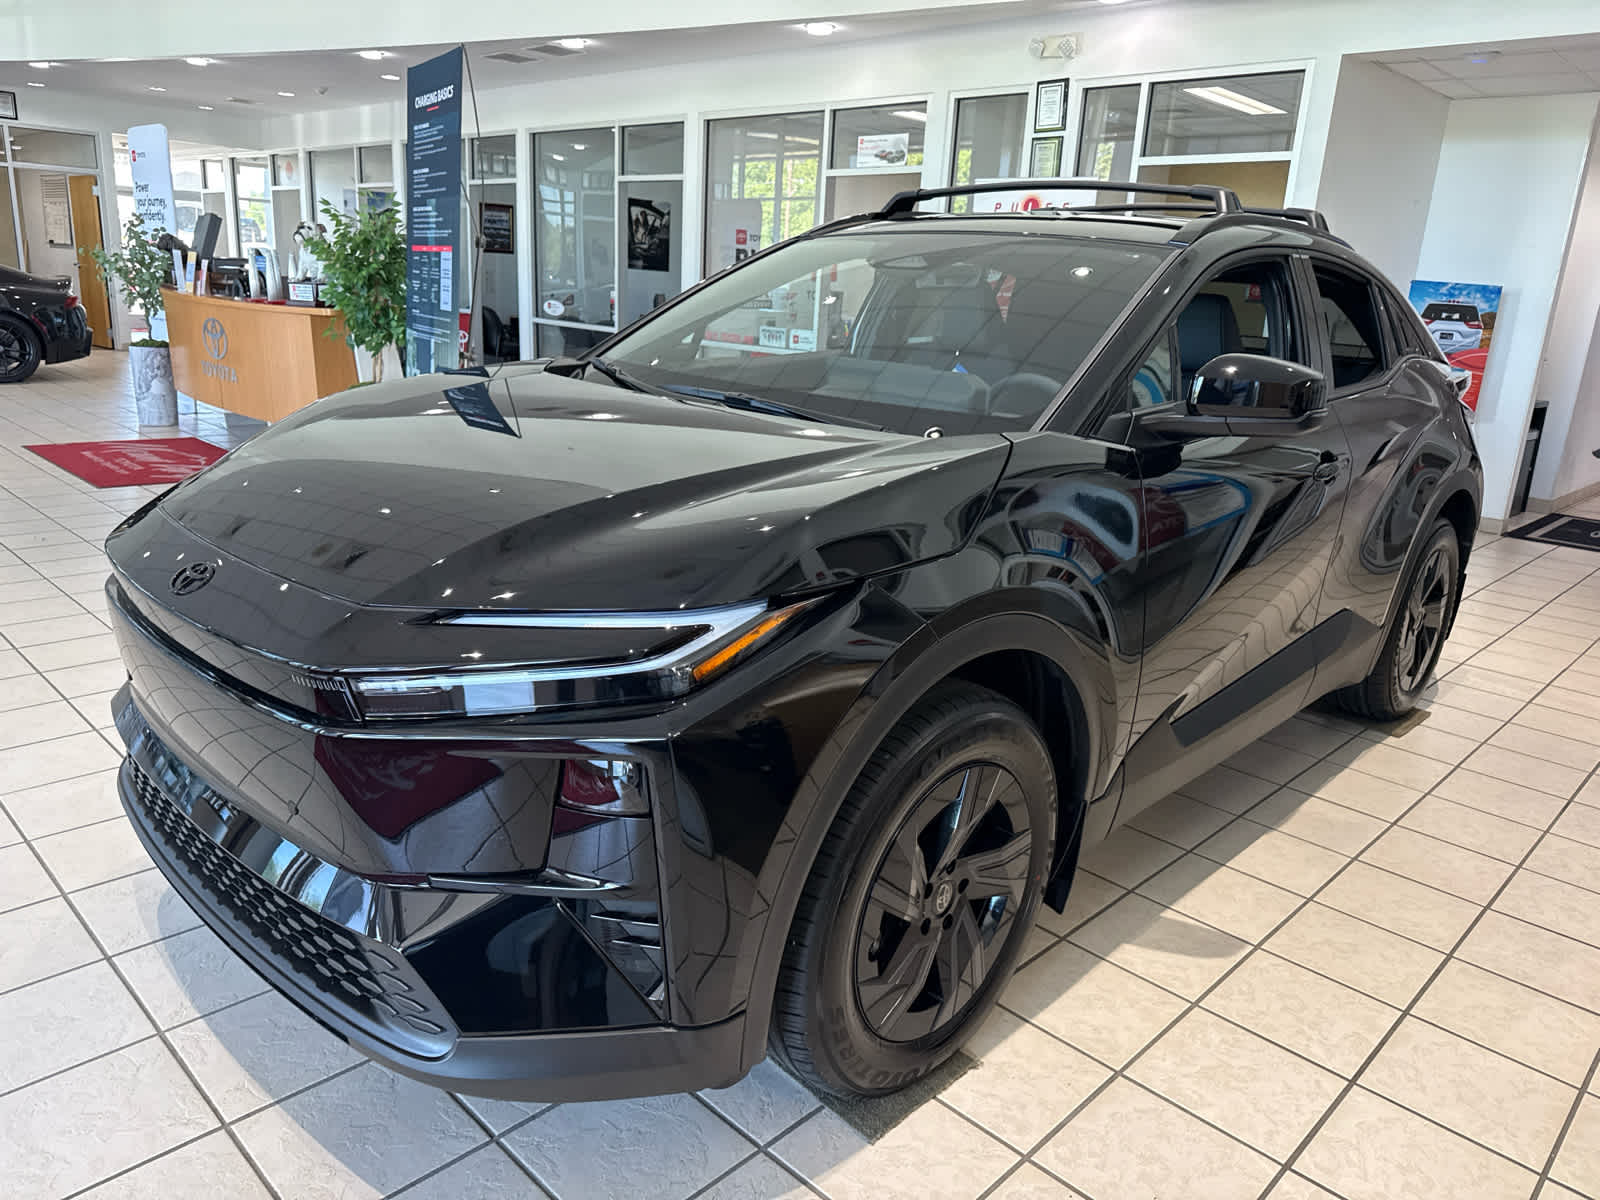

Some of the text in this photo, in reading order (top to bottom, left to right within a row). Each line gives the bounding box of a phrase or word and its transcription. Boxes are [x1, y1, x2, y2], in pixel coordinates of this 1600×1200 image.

[414, 84, 454, 109] CHARGING BASICS
[135, 181, 150, 193] Power
[136, 198, 147, 210] your
[201, 360, 239, 384] TOYOTA
